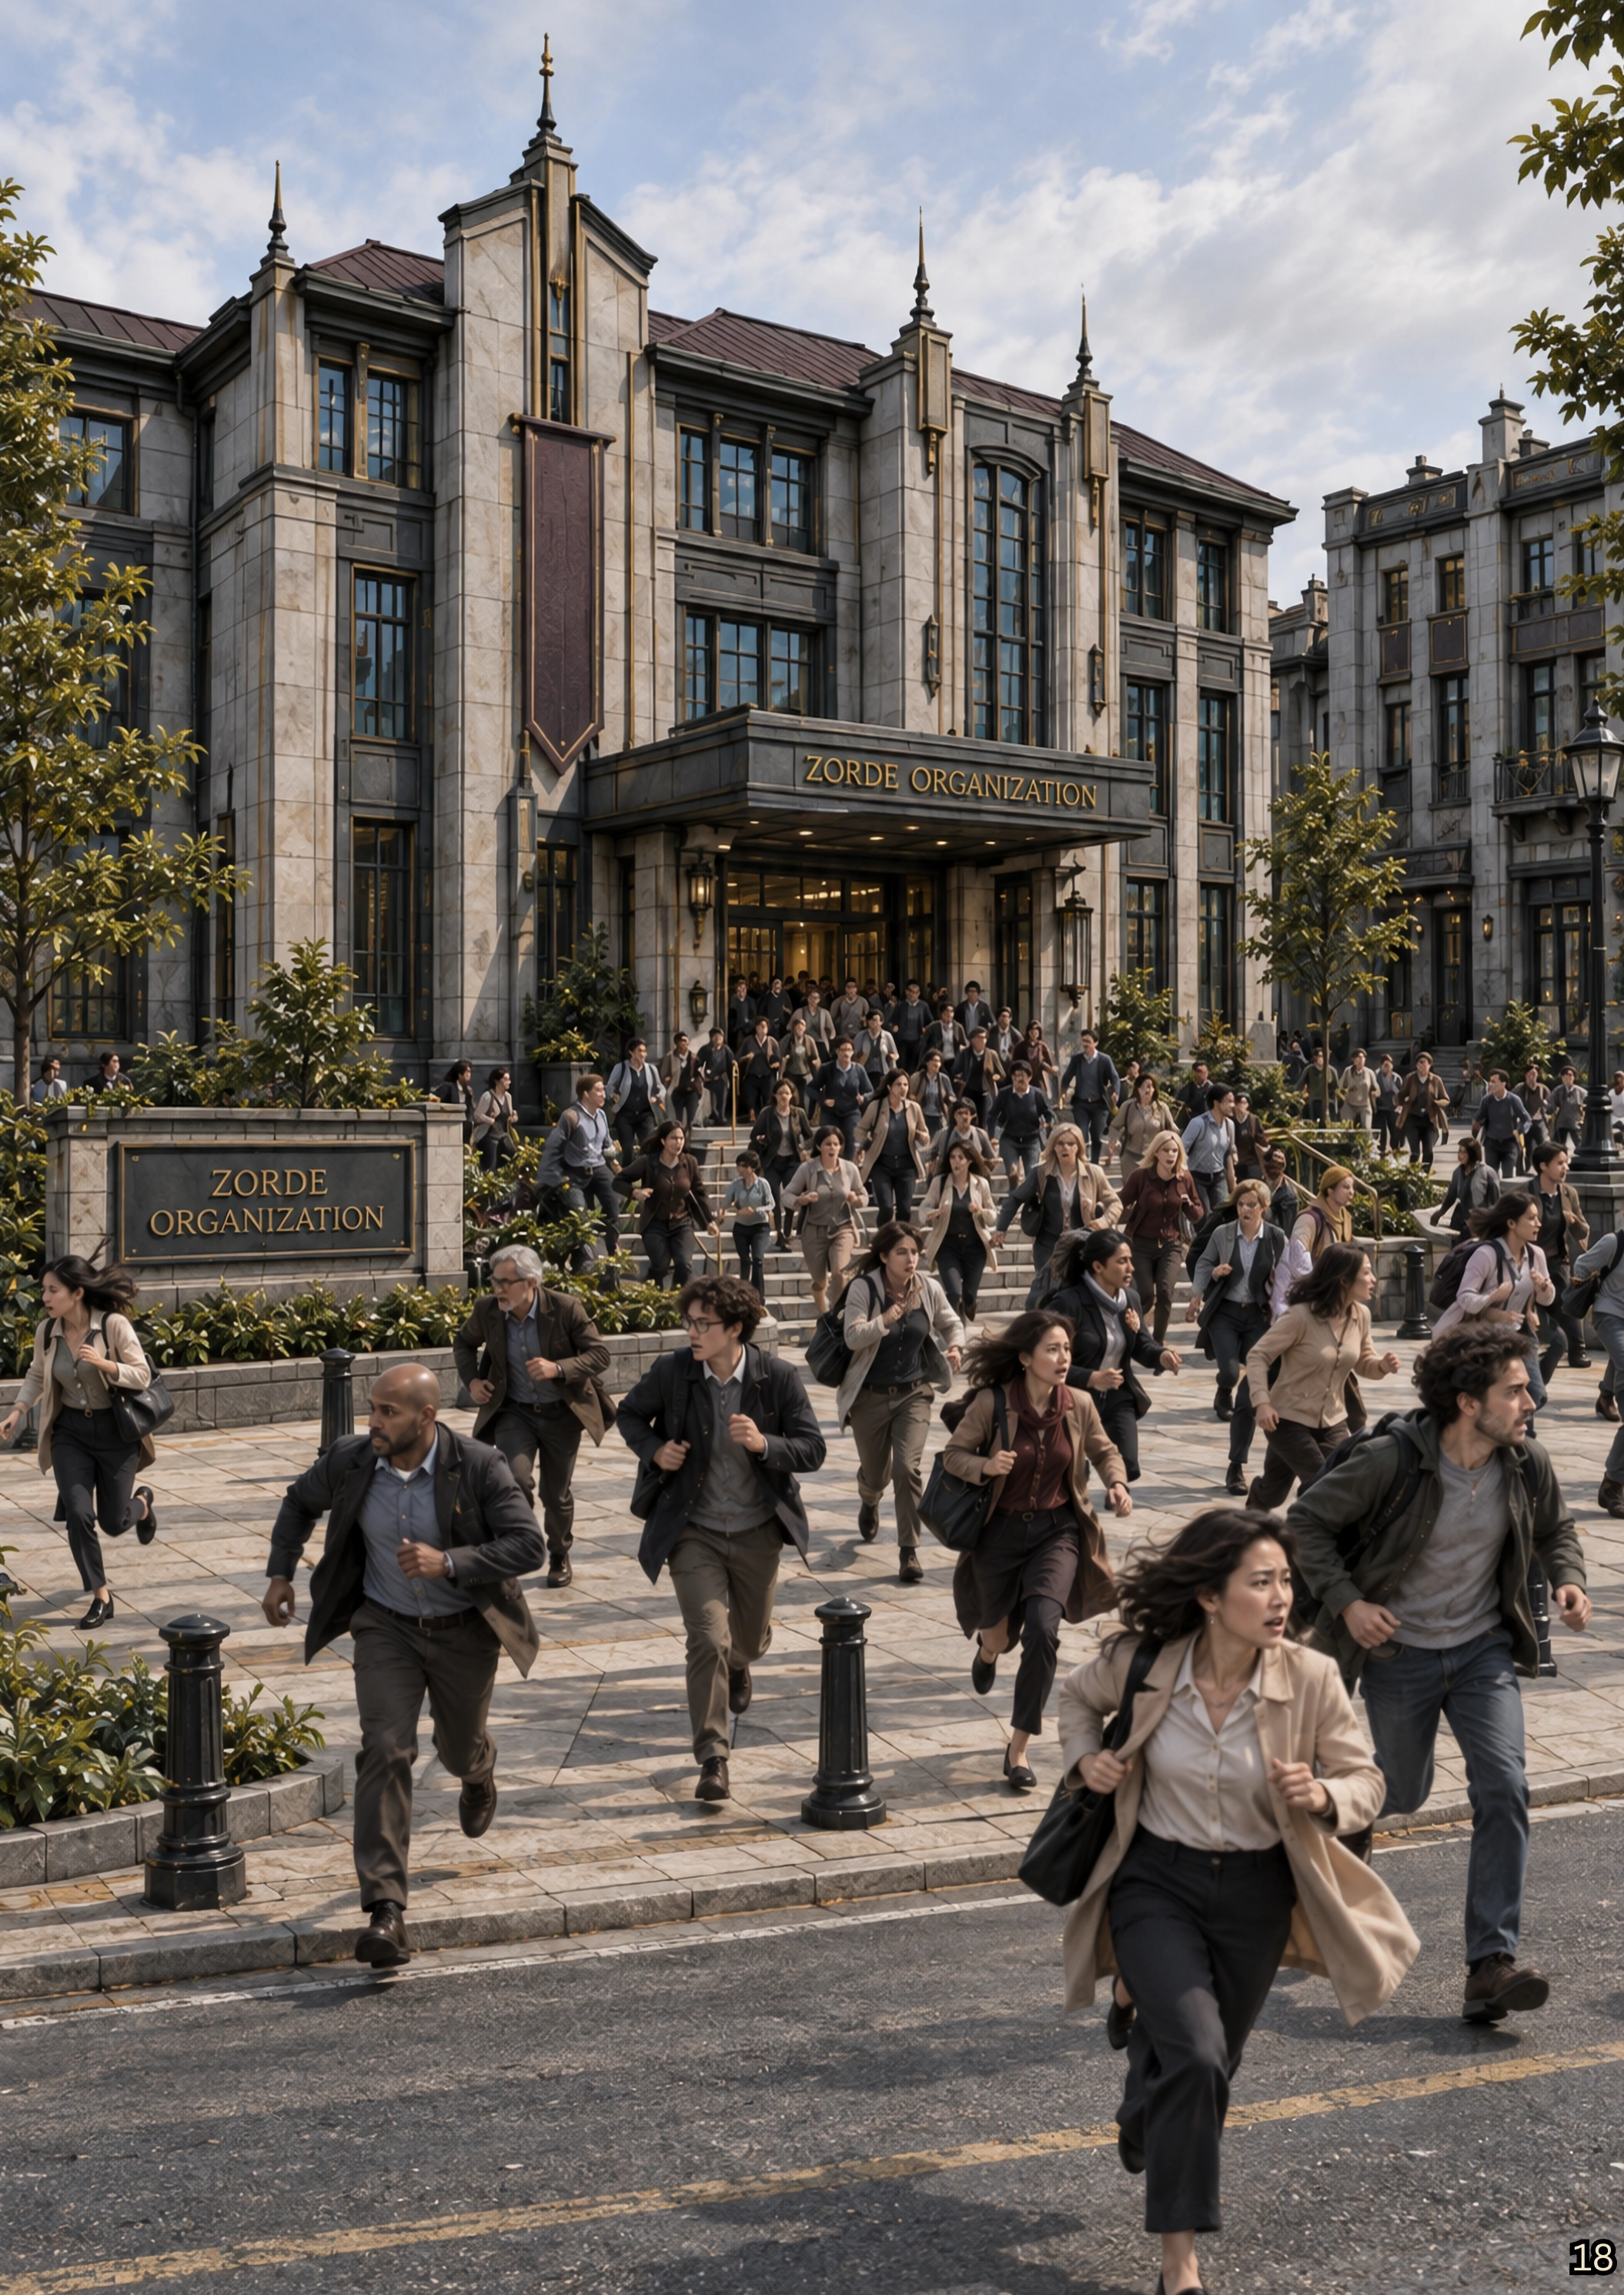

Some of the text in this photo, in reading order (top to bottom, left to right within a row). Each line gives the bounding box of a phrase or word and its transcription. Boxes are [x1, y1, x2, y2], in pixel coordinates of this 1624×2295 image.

[805, 755, 1098, 807] ZORDE ORGANIZATION
[212, 1168, 328, 1197] ZORDE
[149, 1205, 384, 1236] ORGANIZATION
